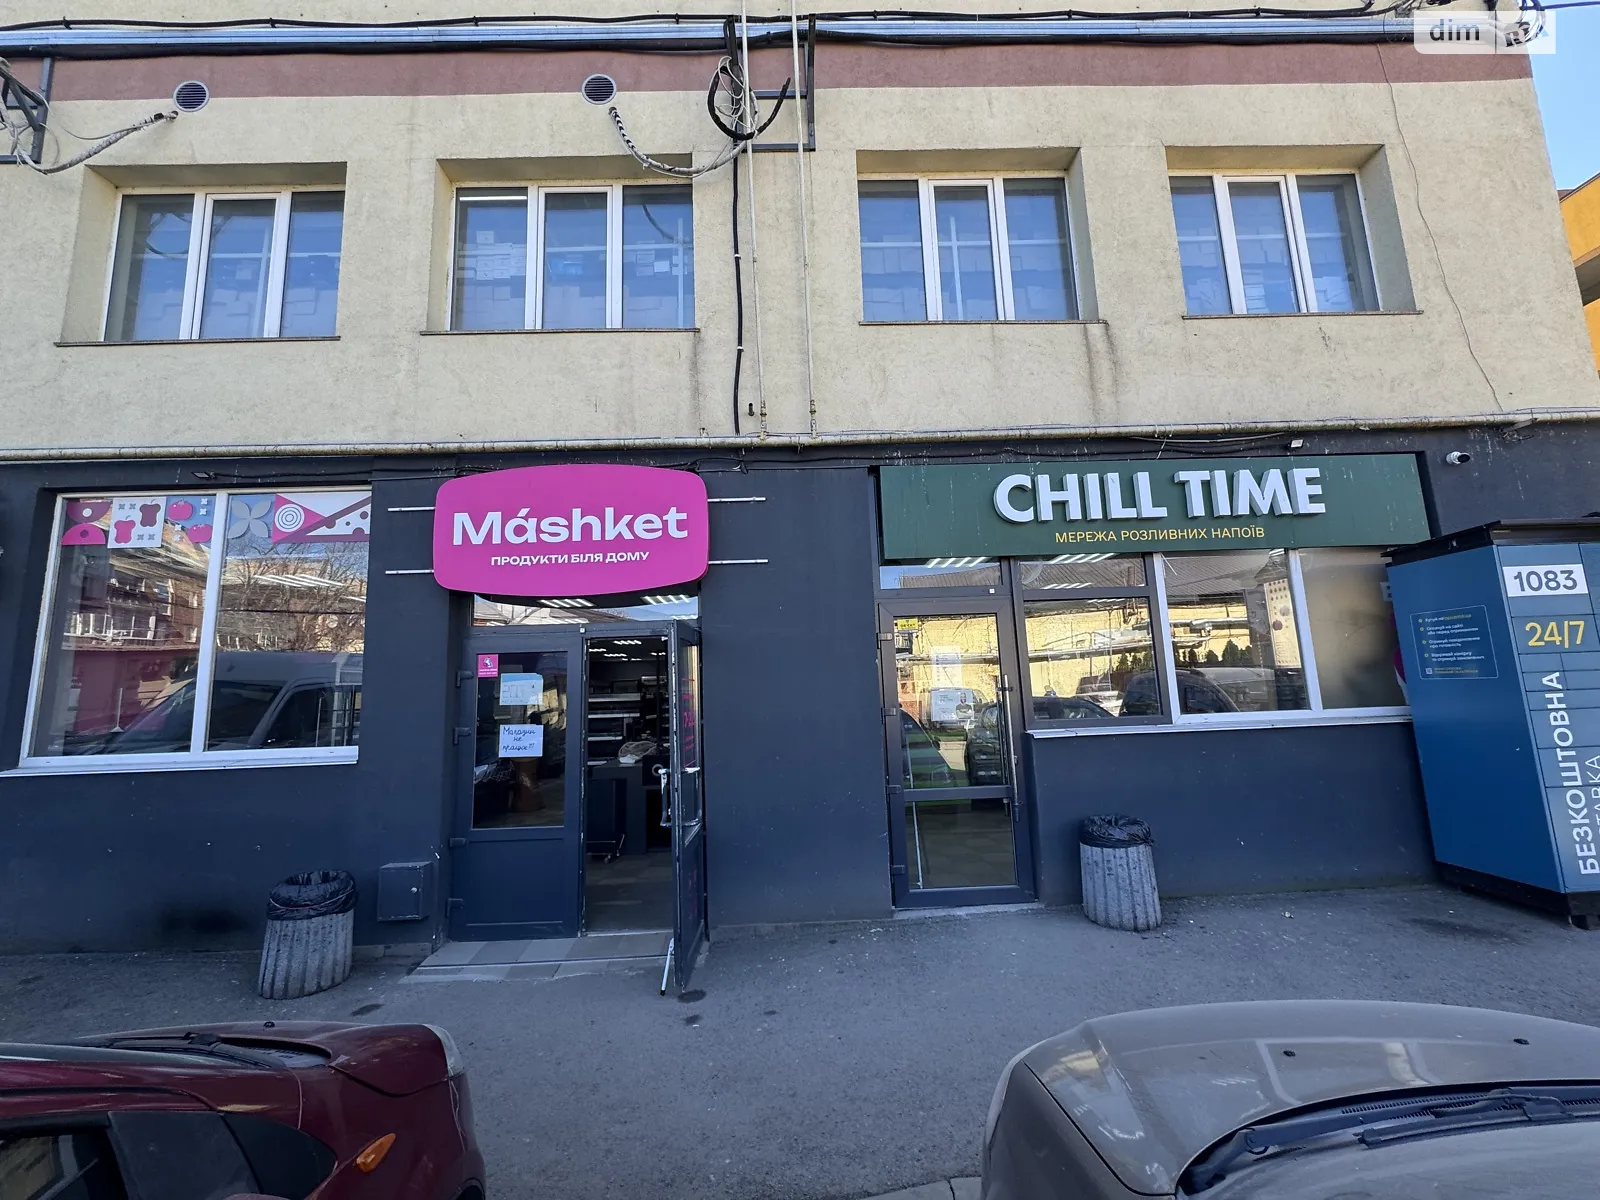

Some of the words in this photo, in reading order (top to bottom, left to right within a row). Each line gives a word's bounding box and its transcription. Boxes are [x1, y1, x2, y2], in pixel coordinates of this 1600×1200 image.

[993, 471, 1168, 524] CHILL
[1174, 468, 1326, 518] TIME
[453, 507, 688, 545] Máshket
[1055, 530, 1117, 543] МЕРЕЖА
[1121, 528, 1208, 541] РОЗЛИВНИХ
[1212, 526, 1265, 539] НАПОЇВ
[491, 554, 568, 566] ПРОДУКТИ
[571, 552, 603, 563] БІЛЯ
[606, 551, 650, 564] ДОМУ
[1514, 570, 1577, 592] 1083
[1542, 672, 1600, 874] БЕЗКОШТОВНА
